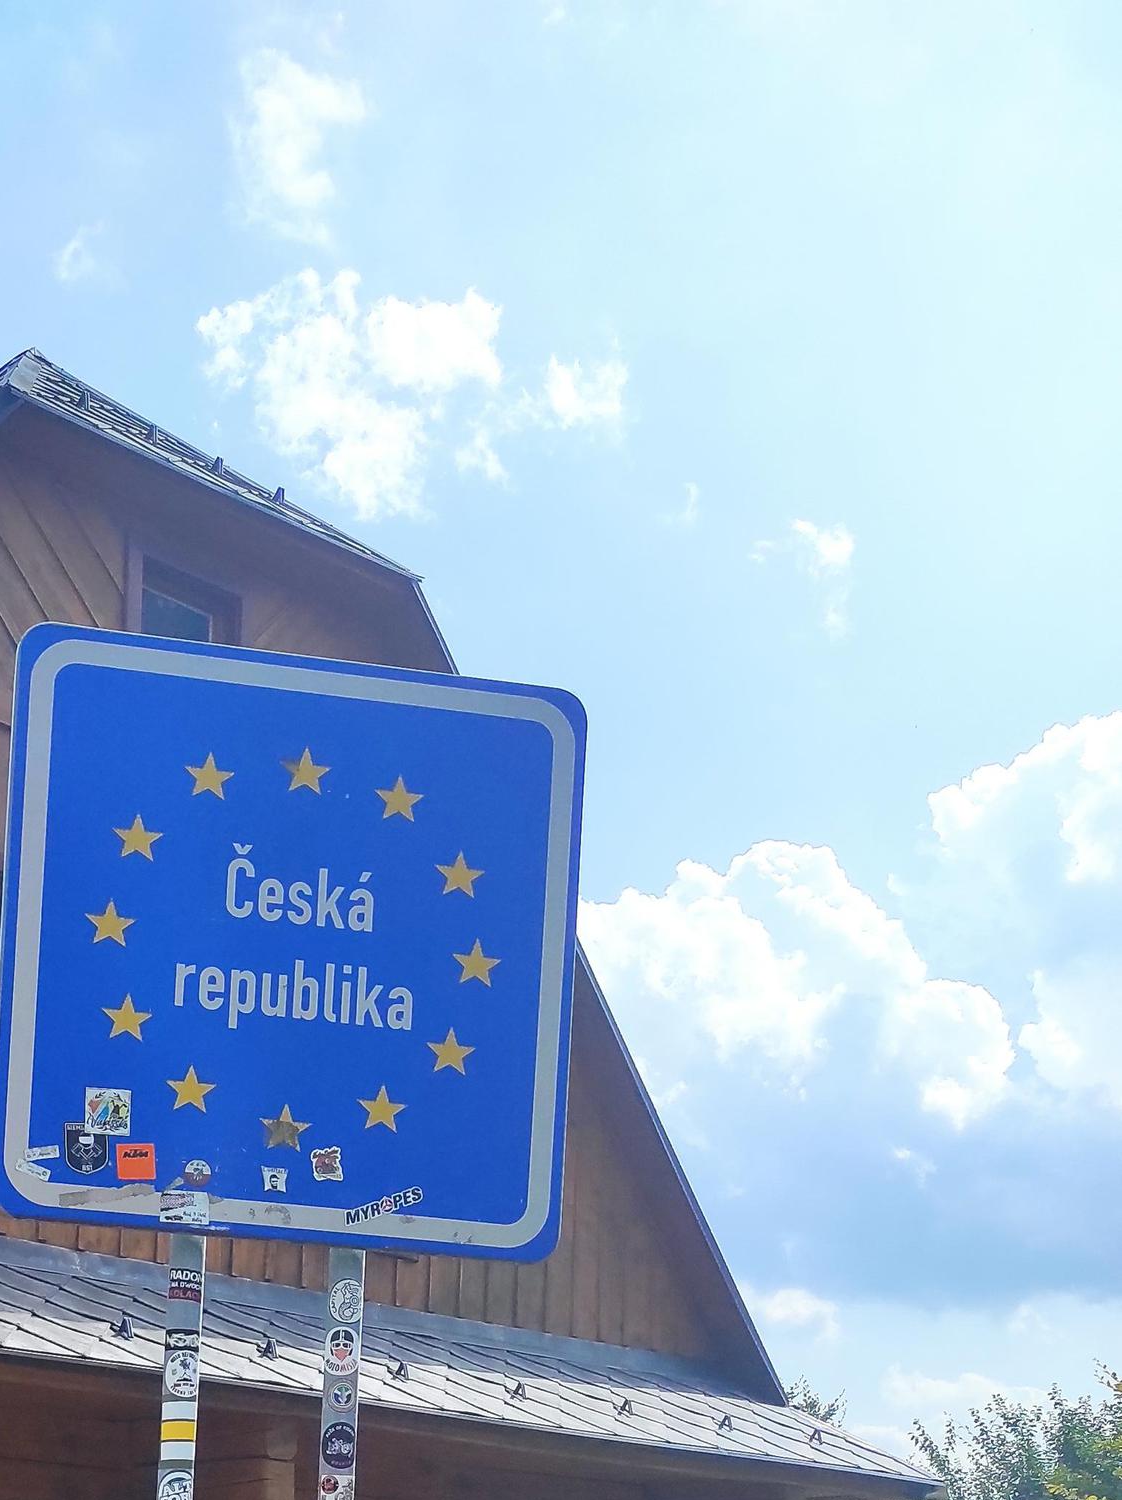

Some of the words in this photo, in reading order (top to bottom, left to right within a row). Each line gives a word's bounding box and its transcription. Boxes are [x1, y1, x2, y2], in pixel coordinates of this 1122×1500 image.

[226, 843, 375, 933] Česká
[174, 959, 414, 1031] republika
[346, 1187, 422, 1225] MYROPES
